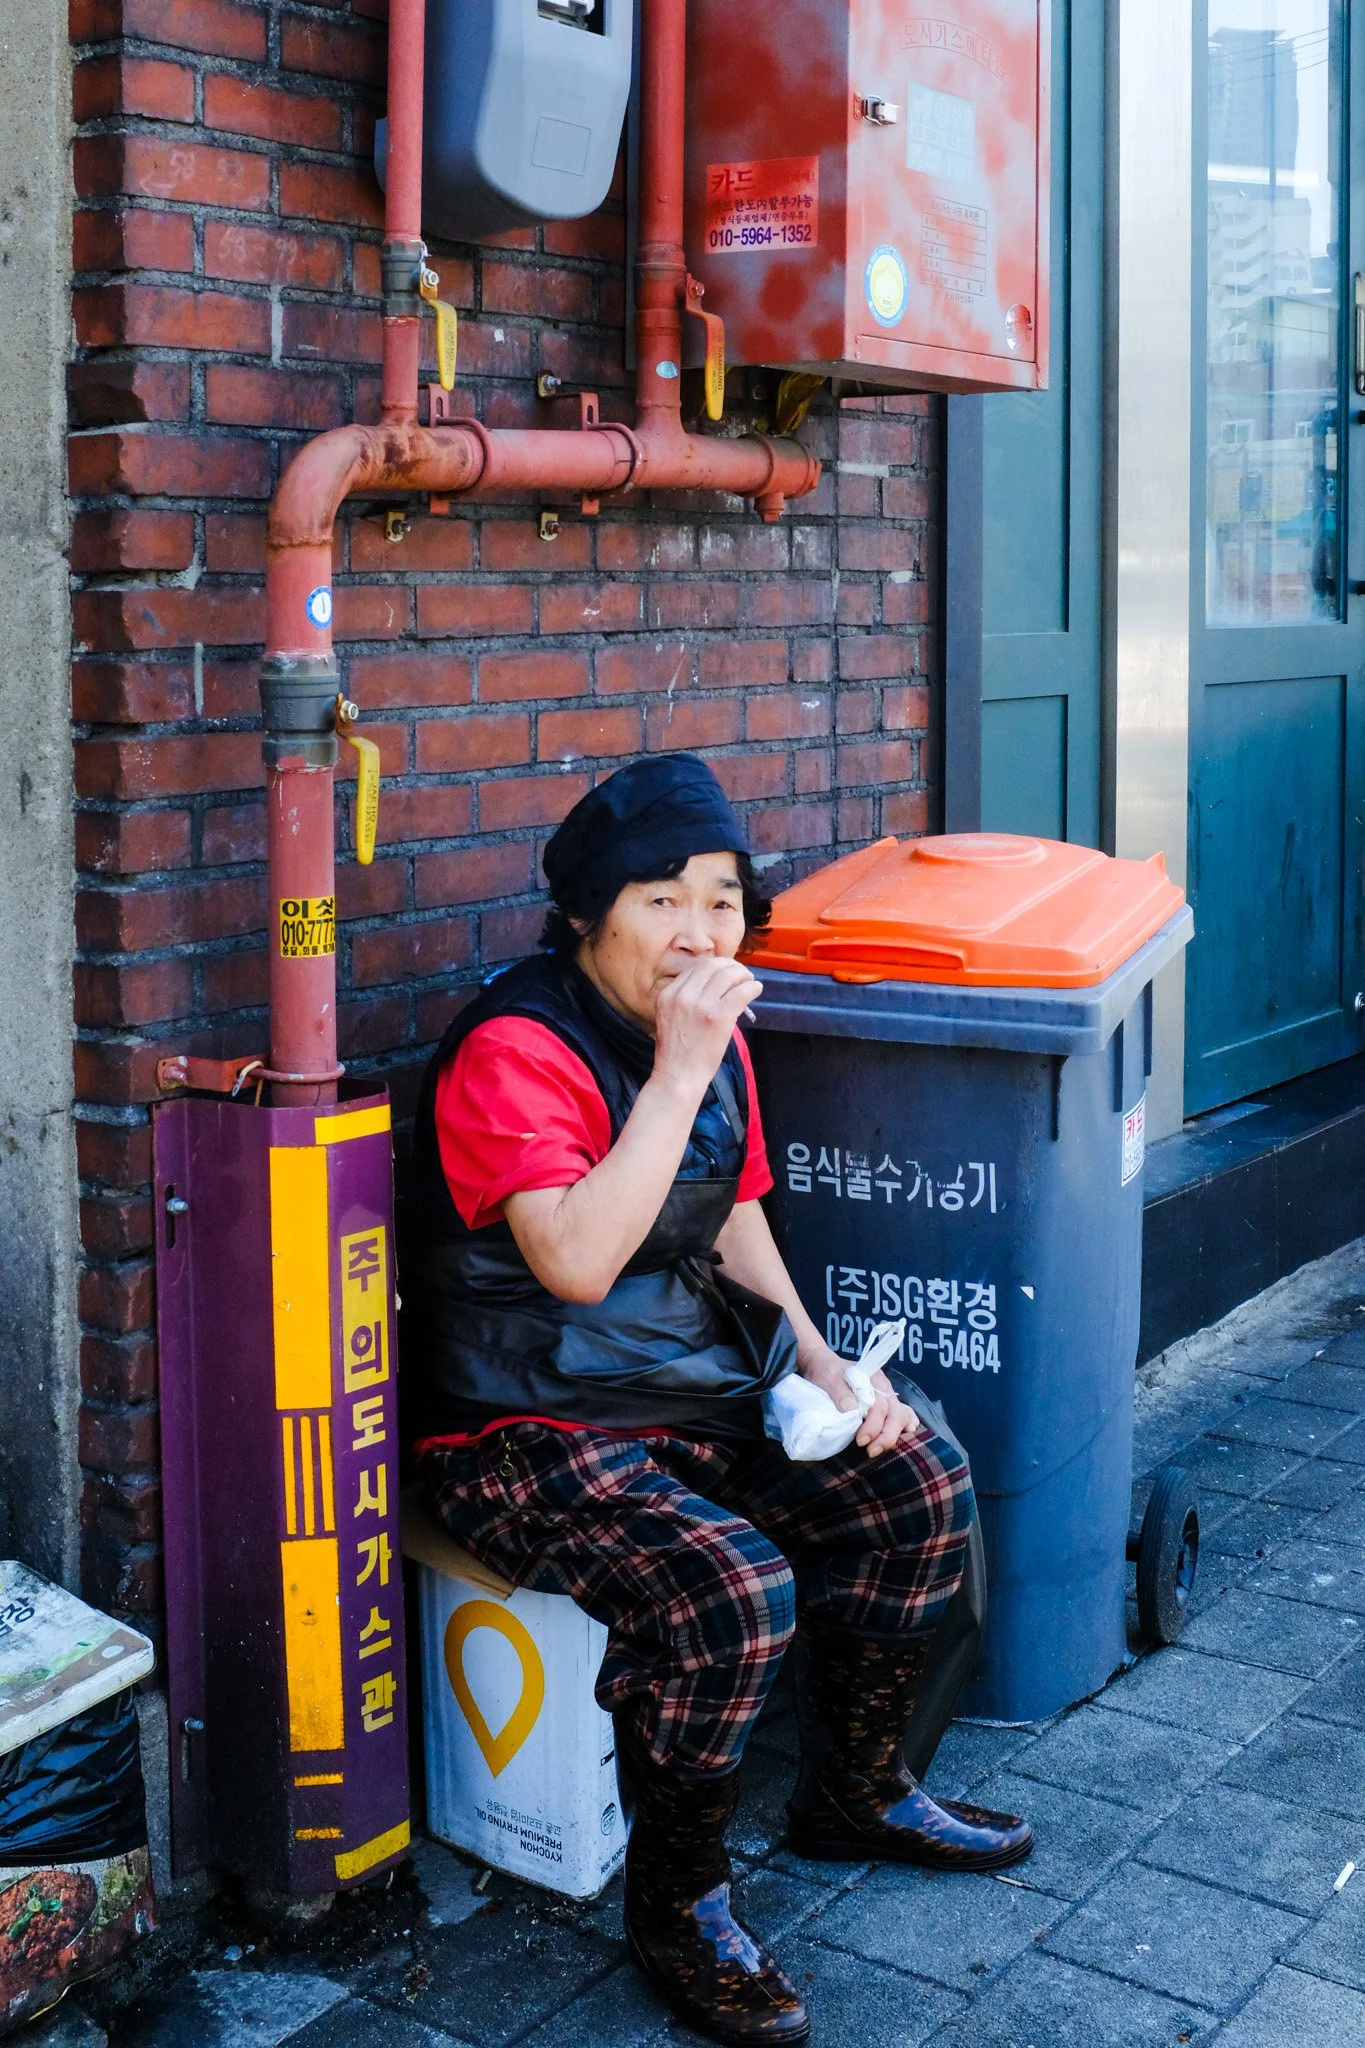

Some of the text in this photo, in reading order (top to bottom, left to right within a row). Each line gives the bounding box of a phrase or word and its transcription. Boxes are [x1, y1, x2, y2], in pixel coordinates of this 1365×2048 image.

[709, 224, 812, 248] 010-5964-1352
[348, 1237, 383, 1375] 주의
[488, 1814, 518, 1835] FRYING
[520, 1827, 562, 1851] PREMIUM
[520, 1839, 562, 1864] KYOCHON
